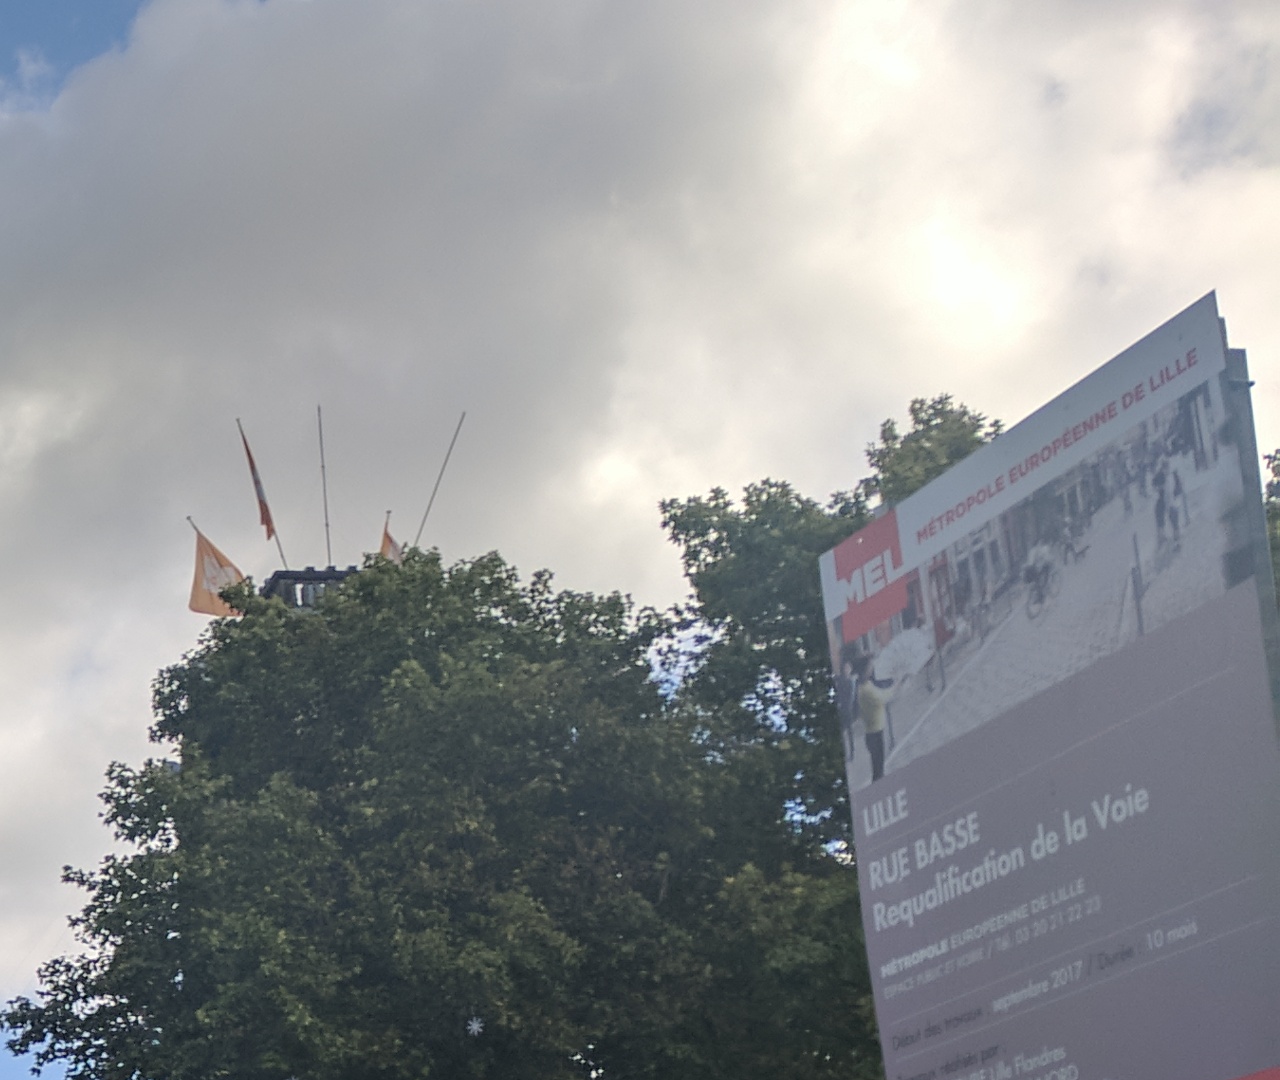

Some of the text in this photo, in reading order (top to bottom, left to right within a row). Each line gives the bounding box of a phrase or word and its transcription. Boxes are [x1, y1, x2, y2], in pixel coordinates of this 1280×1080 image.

[916, 347, 1200, 544] MÉTROPOLE EUROPÉENNE DE LILLE
[836, 546, 904, 612] MEL
[863, 788, 909, 836] LILLE
[869, 811, 981, 890] RUE BASSE
[873, 783, 1150, 933] Requalification de la Voie
[1031, 892, 1050, 915] DE
[1050, 876, 1085, 906] LILLE
[1049, 958, 1084, 991] 2017
[1145, 927, 1165, 952] 10
[1014, 1045, 1067, 1075] Flandres
